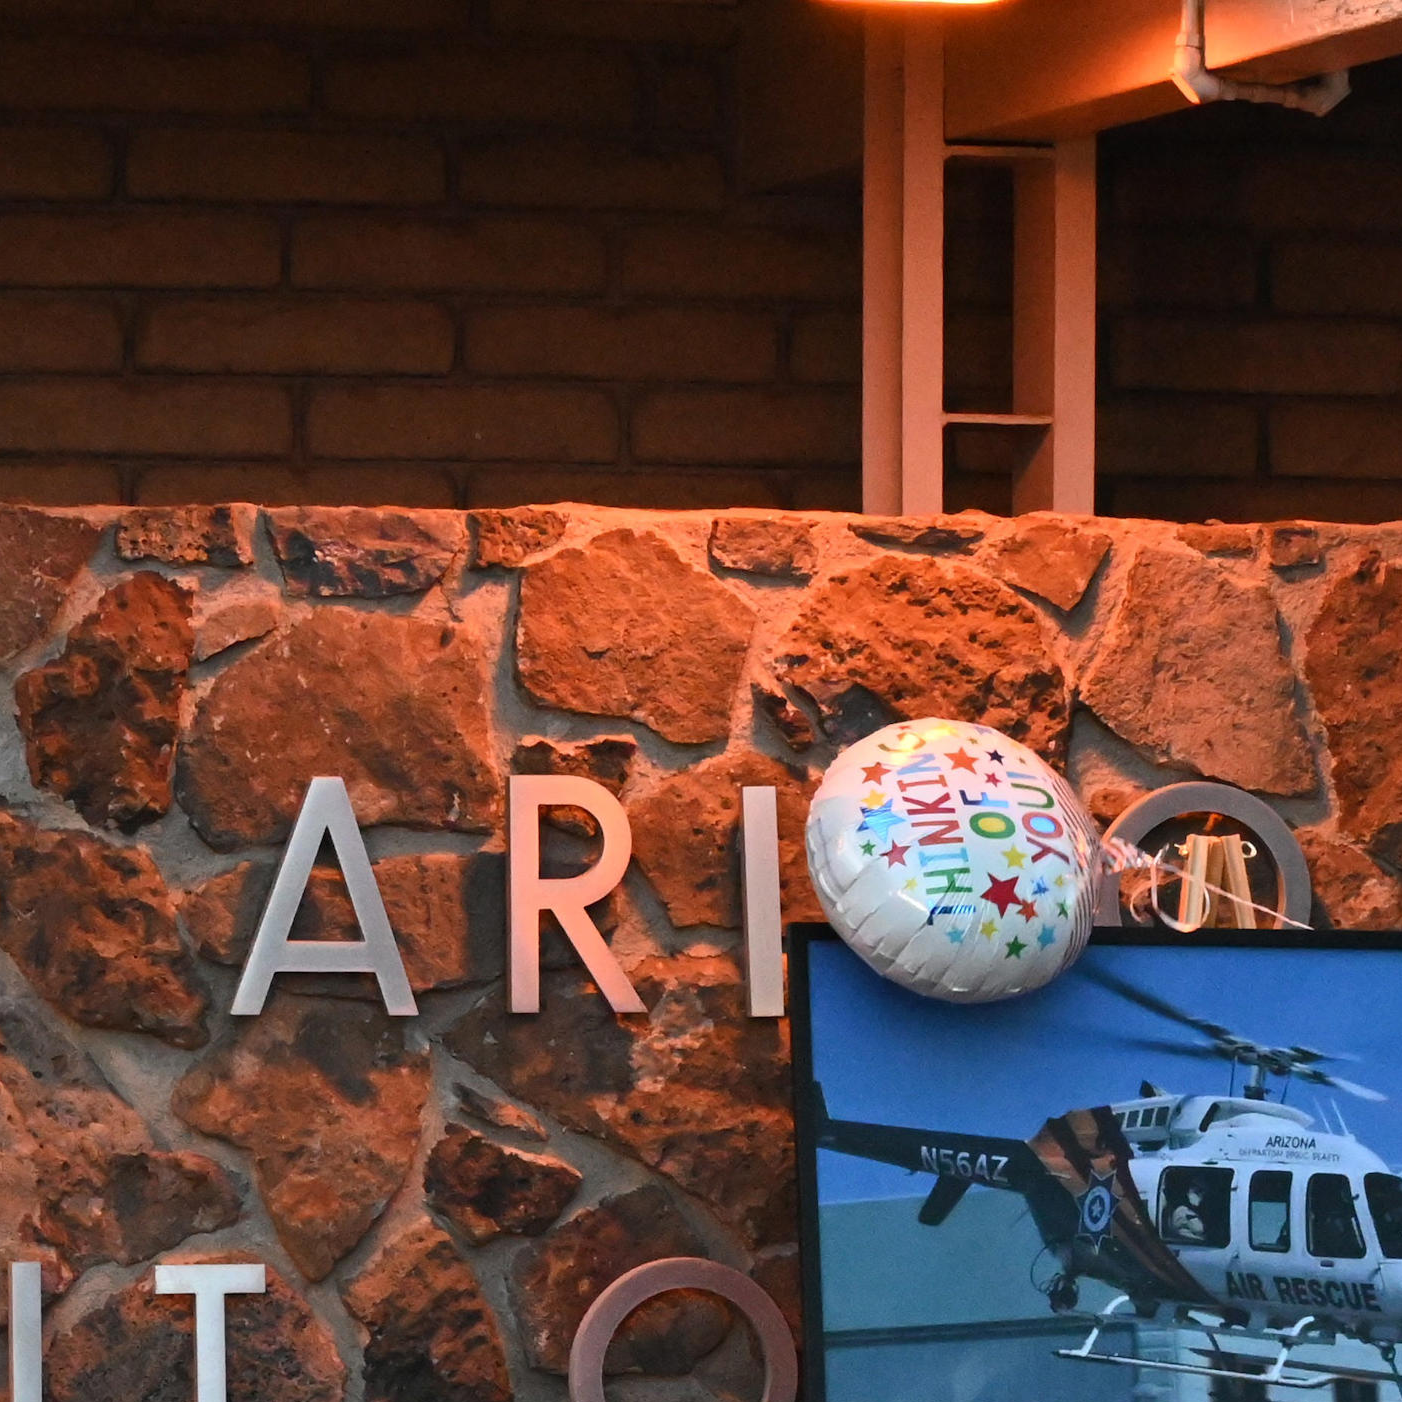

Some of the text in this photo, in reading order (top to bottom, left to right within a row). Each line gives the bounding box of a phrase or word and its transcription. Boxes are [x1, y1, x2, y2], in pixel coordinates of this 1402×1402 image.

[959, 790, 1016, 839] OF
[1265, 1135, 1317, 1150] ARIZONA
[919, 1144, 1010, 1184] N564Z
[1225, 1270, 1382, 1313] AIR RESCUE
